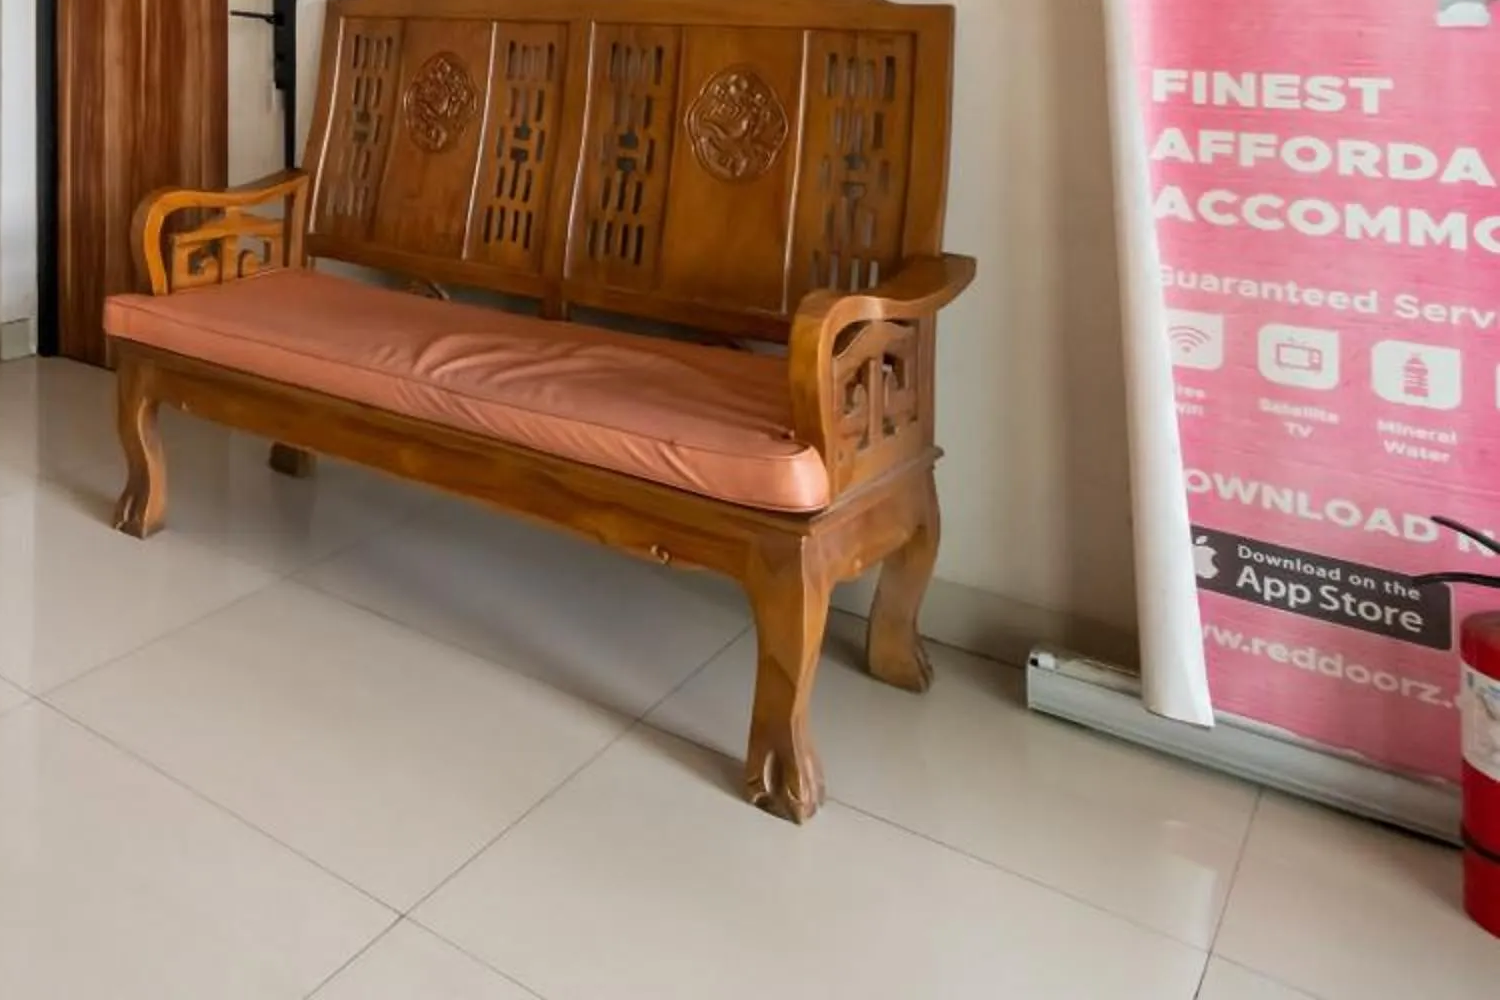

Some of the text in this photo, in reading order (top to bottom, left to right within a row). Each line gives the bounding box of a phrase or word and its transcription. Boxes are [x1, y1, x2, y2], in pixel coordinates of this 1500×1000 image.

[1151, 68, 1394, 115] FINEST
[1150, 126, 1498, 188] AFFORDA
[1393, 292, 1496, 329] Serv
[1283, 421, 1316, 440] TV
[1376, 418, 1458, 446] Mineral
[1383, 439, 1451, 464] Water
[1236, 544, 1422, 602] Download on the
[1236, 565, 1424, 634] App Store
